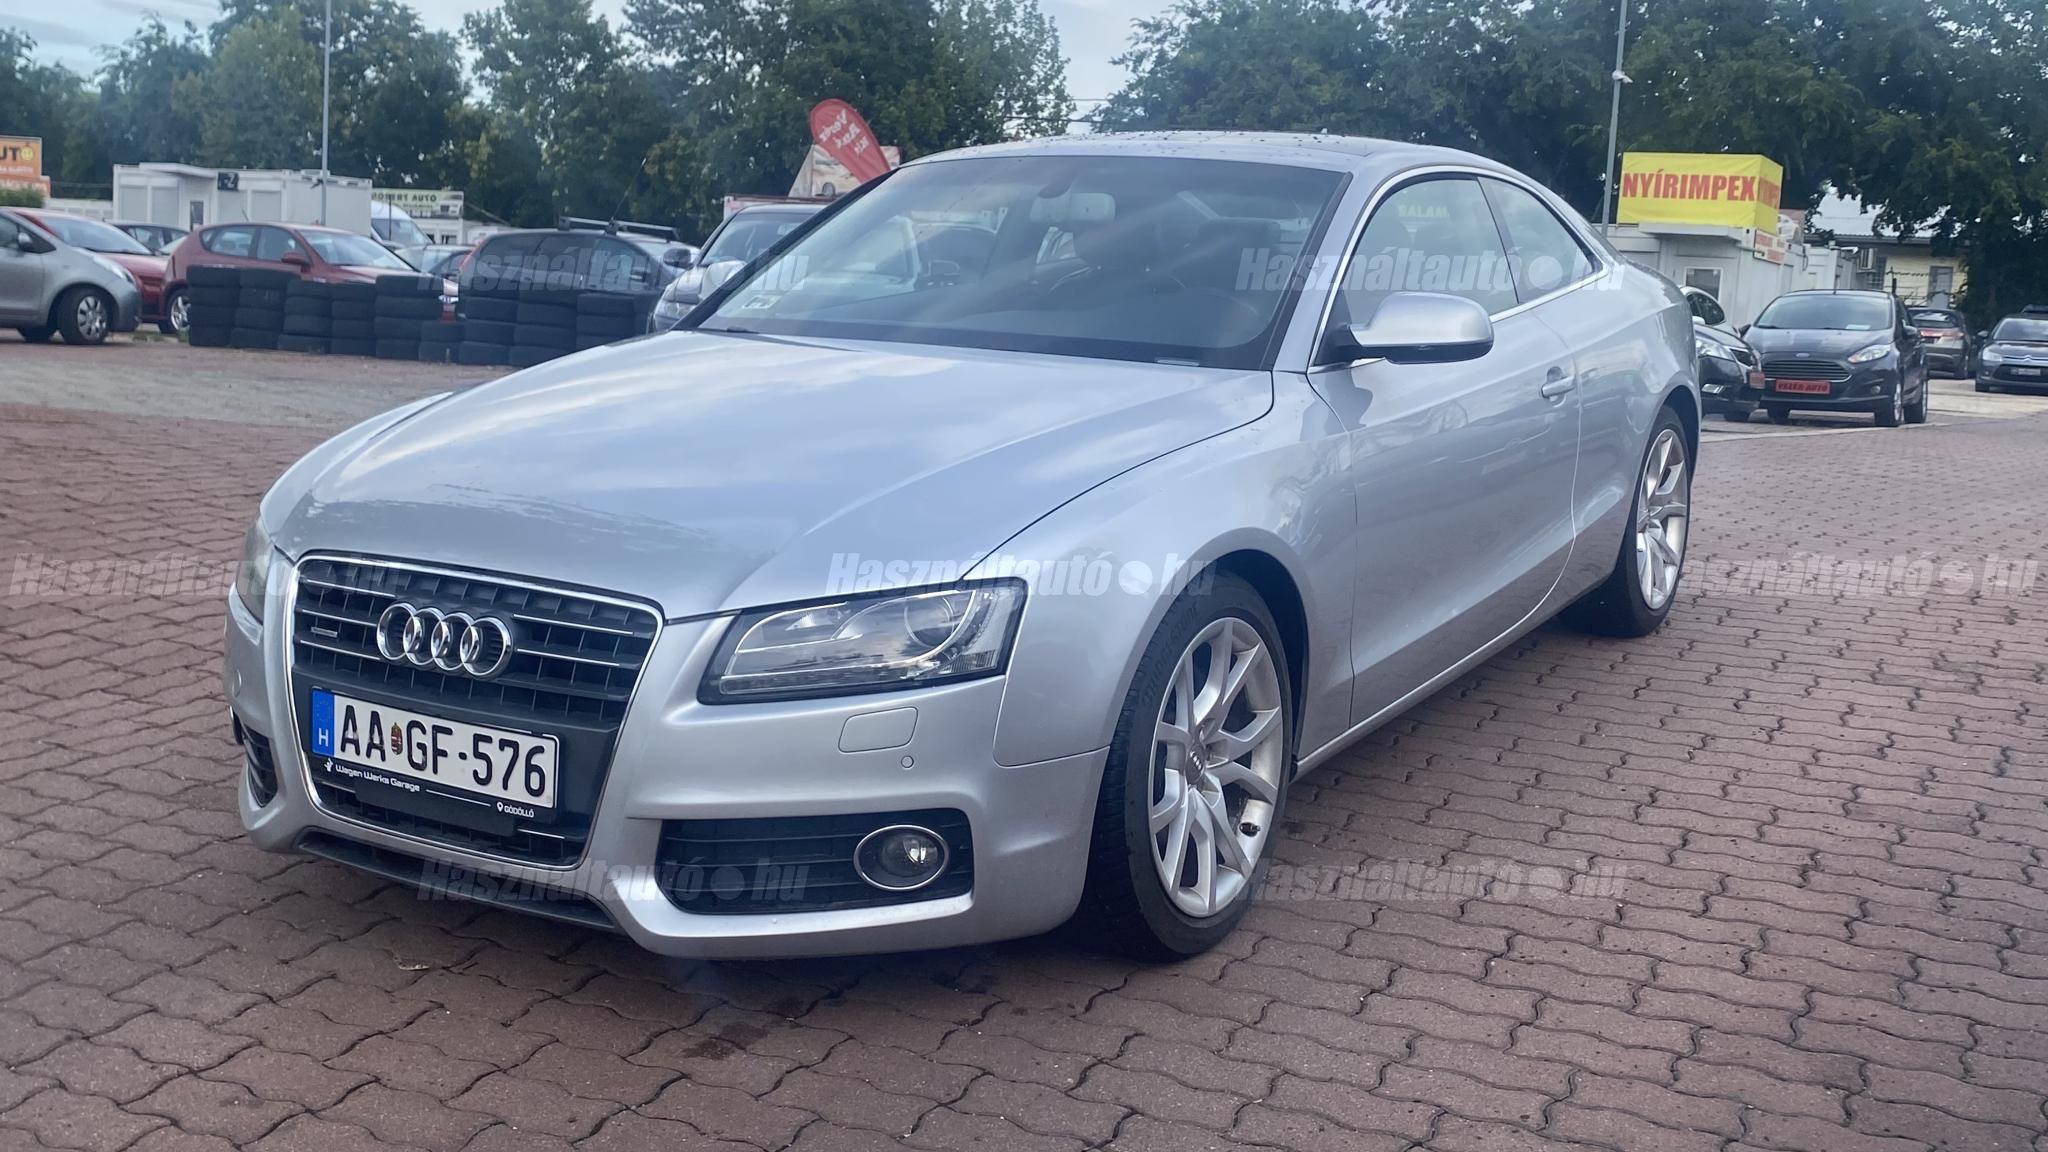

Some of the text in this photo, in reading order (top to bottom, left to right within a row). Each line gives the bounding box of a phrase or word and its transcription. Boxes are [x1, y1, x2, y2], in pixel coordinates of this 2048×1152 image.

[1622, 168, 1756, 201] NYÍRIMPEX
[318, 728, 329, 747] H
[340, 704, 386, 762] AA
[335, 764, 420, 792] Wagen Werks Garage
